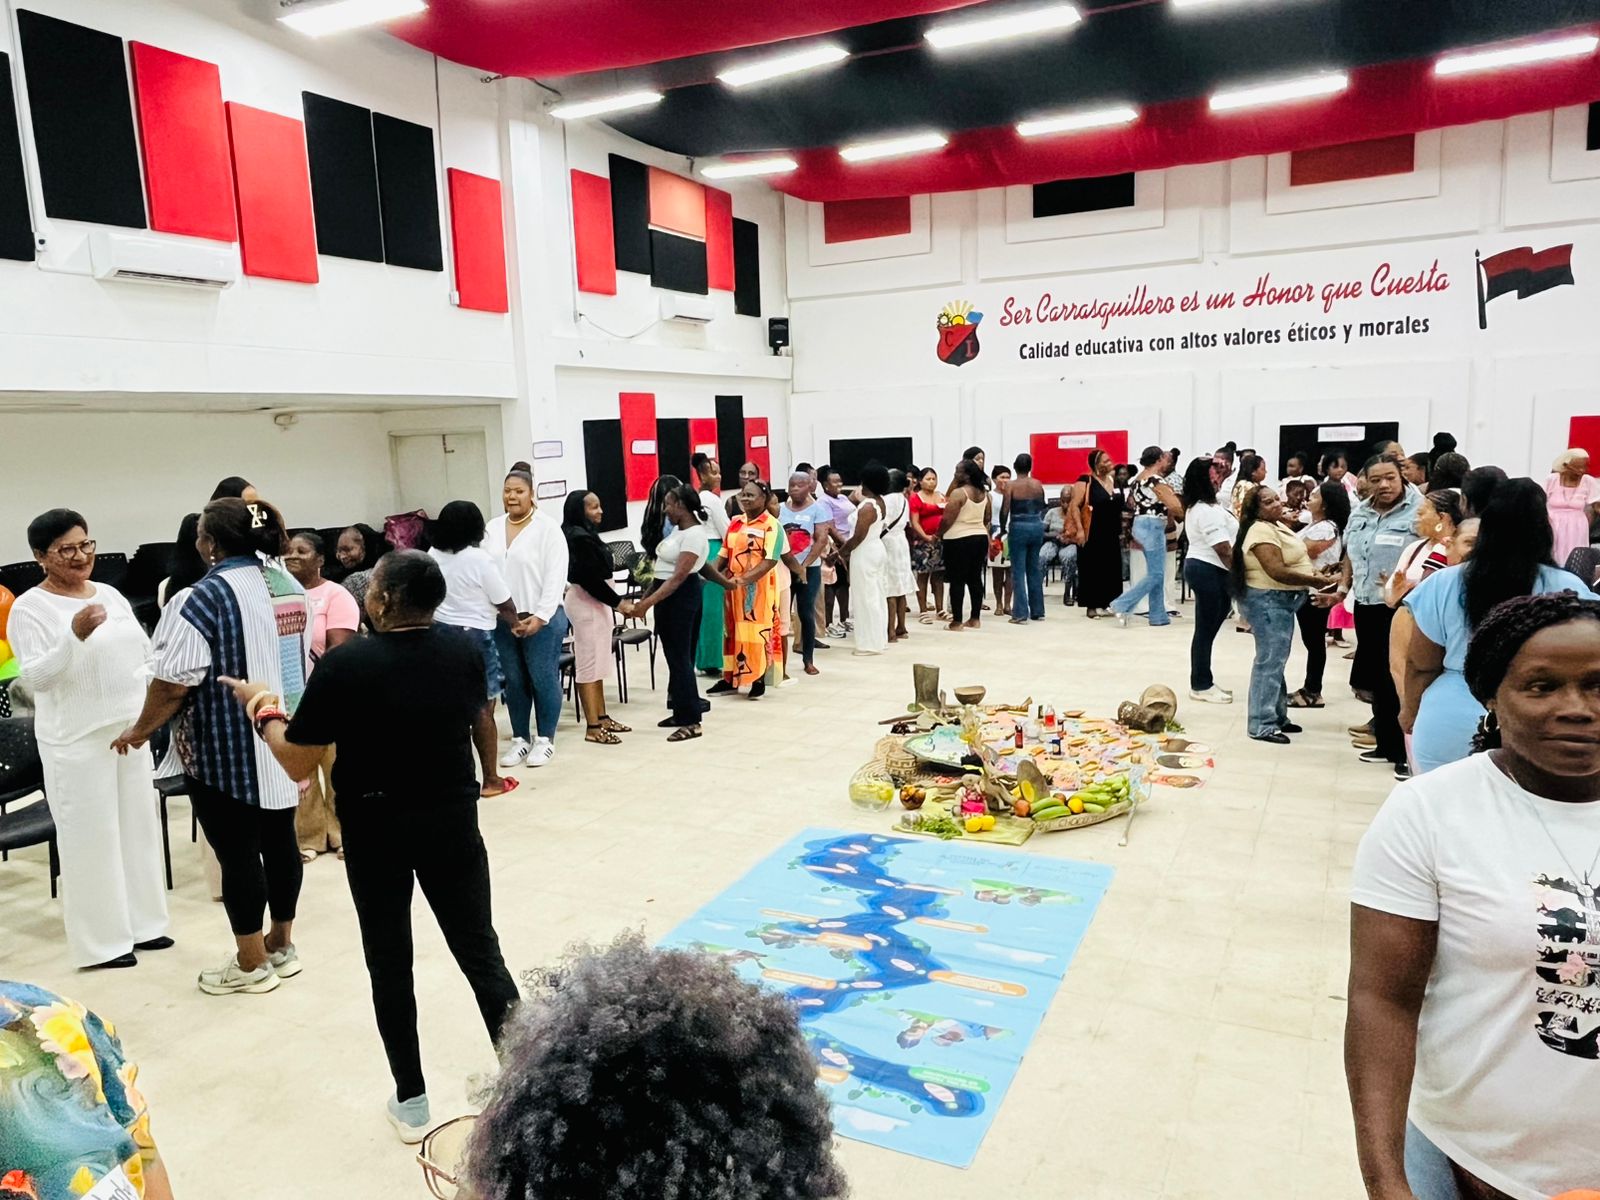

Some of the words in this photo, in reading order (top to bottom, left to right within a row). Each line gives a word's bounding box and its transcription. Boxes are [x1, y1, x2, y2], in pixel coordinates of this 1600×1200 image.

[1000, 296, 1032, 326] Ser
[1036, 284, 1175, 330] Carrasquillero
[1180, 290, 1200, 312] es
[1206, 292, 1236, 309] un
[1242, 272, 1315, 307] Honor
[1321, 280, 1362, 313] que
[1370, 259, 1450, 297] Cuesta
[1019, 340, 1069, 360] Calidad
[1075, 336, 1143, 356] educativa
[1149, 336, 1175, 351] con
[1181, 331, 1217, 349] altos
[1223, 328, 1281, 346] valores
[1287, 322, 1336, 342] éticos
[1343, 323, 1352, 344] y
[1359, 315, 1430, 337] morales
